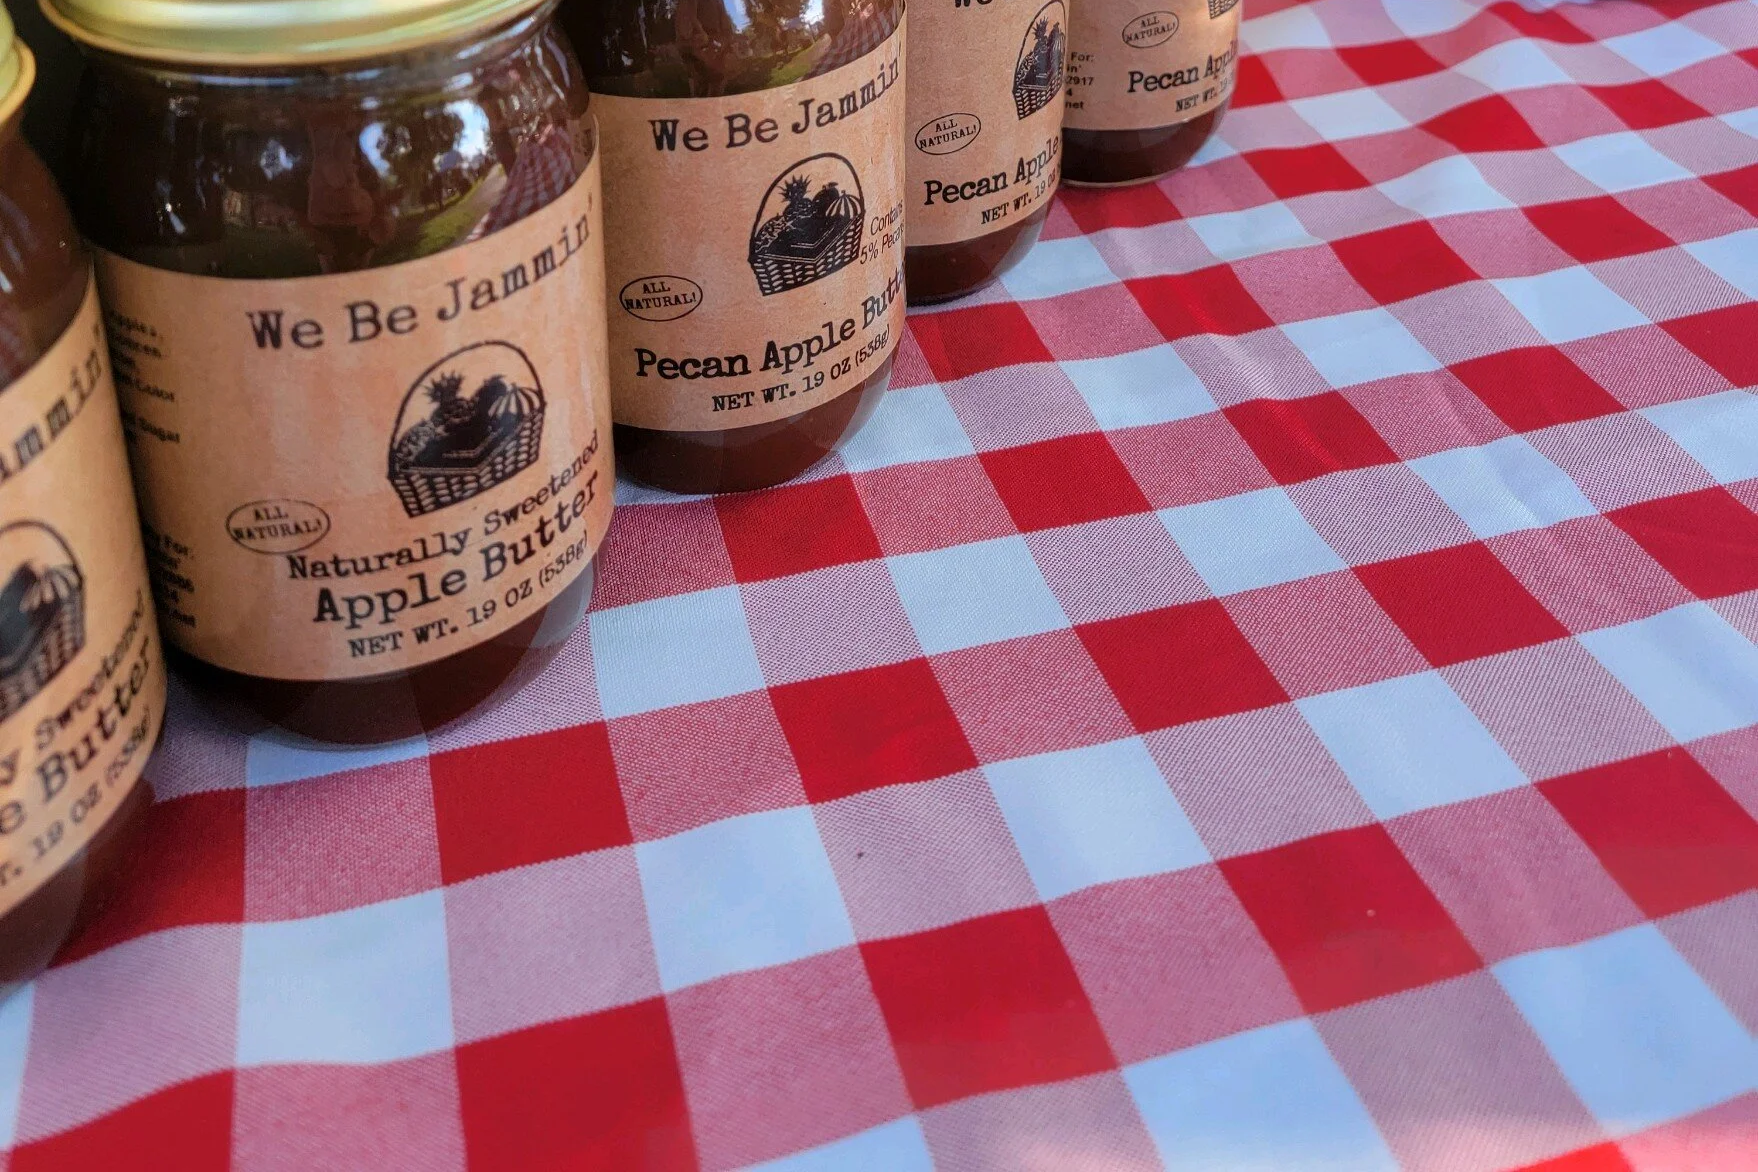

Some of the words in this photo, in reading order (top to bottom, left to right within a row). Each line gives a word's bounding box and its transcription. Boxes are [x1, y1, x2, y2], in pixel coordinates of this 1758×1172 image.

[1126, 22, 1176, 43] NATURAL!
[1140, 15, 1161, 28] ALL
[1127, 66, 1199, 93] Pecan
[648, 119, 709, 151] We
[724, 113, 779, 148] Be
[791, 40, 903, 134] Jammin'
[1175, 93, 1200, 112] NET
[918, 124, 977, 150] NATURAL!
[935, 118, 958, 133] ALL
[924, 171, 1008, 206] Pecan
[1013, 136, 1059, 185] Apple
[981, 202, 1009, 225] NET
[1013, 192, 1032, 212] WT.
[1034, 180, 1046, 200] 19
[860, 239, 878, 264] 5%
[245, 309, 325, 351] We
[346, 300, 420, 344] Be
[436, 193, 595, 322] Jammin'
[642, 281, 671, 295] ALL
[625, 292, 698, 312] NATURAL!
[634, 347, 751, 380] Pecan
[759, 318, 857, 376] Apple
[712, 390, 755, 412] NET
[761, 383, 797, 404] WT.
[802, 371, 825, 393] 19
[829, 361, 852, 382] OZ
[854, 324, 891, 371] (538g)
[252, 506, 289, 522] ALL
[287, 525, 472, 581] Naturally
[483, 430, 600, 535] Sweetened
[233, 517, 324, 541] NATURAL!
[312, 567, 467, 631] Apple
[480, 469, 600, 583] Butter
[348, 632, 404, 659] NET
[414, 616, 460, 645] WT.
[466, 601, 497, 629] 19
[505, 579, 535, 608] OZ
[538, 531, 590, 589] (538g)
[37, 636, 152, 805] Butter
